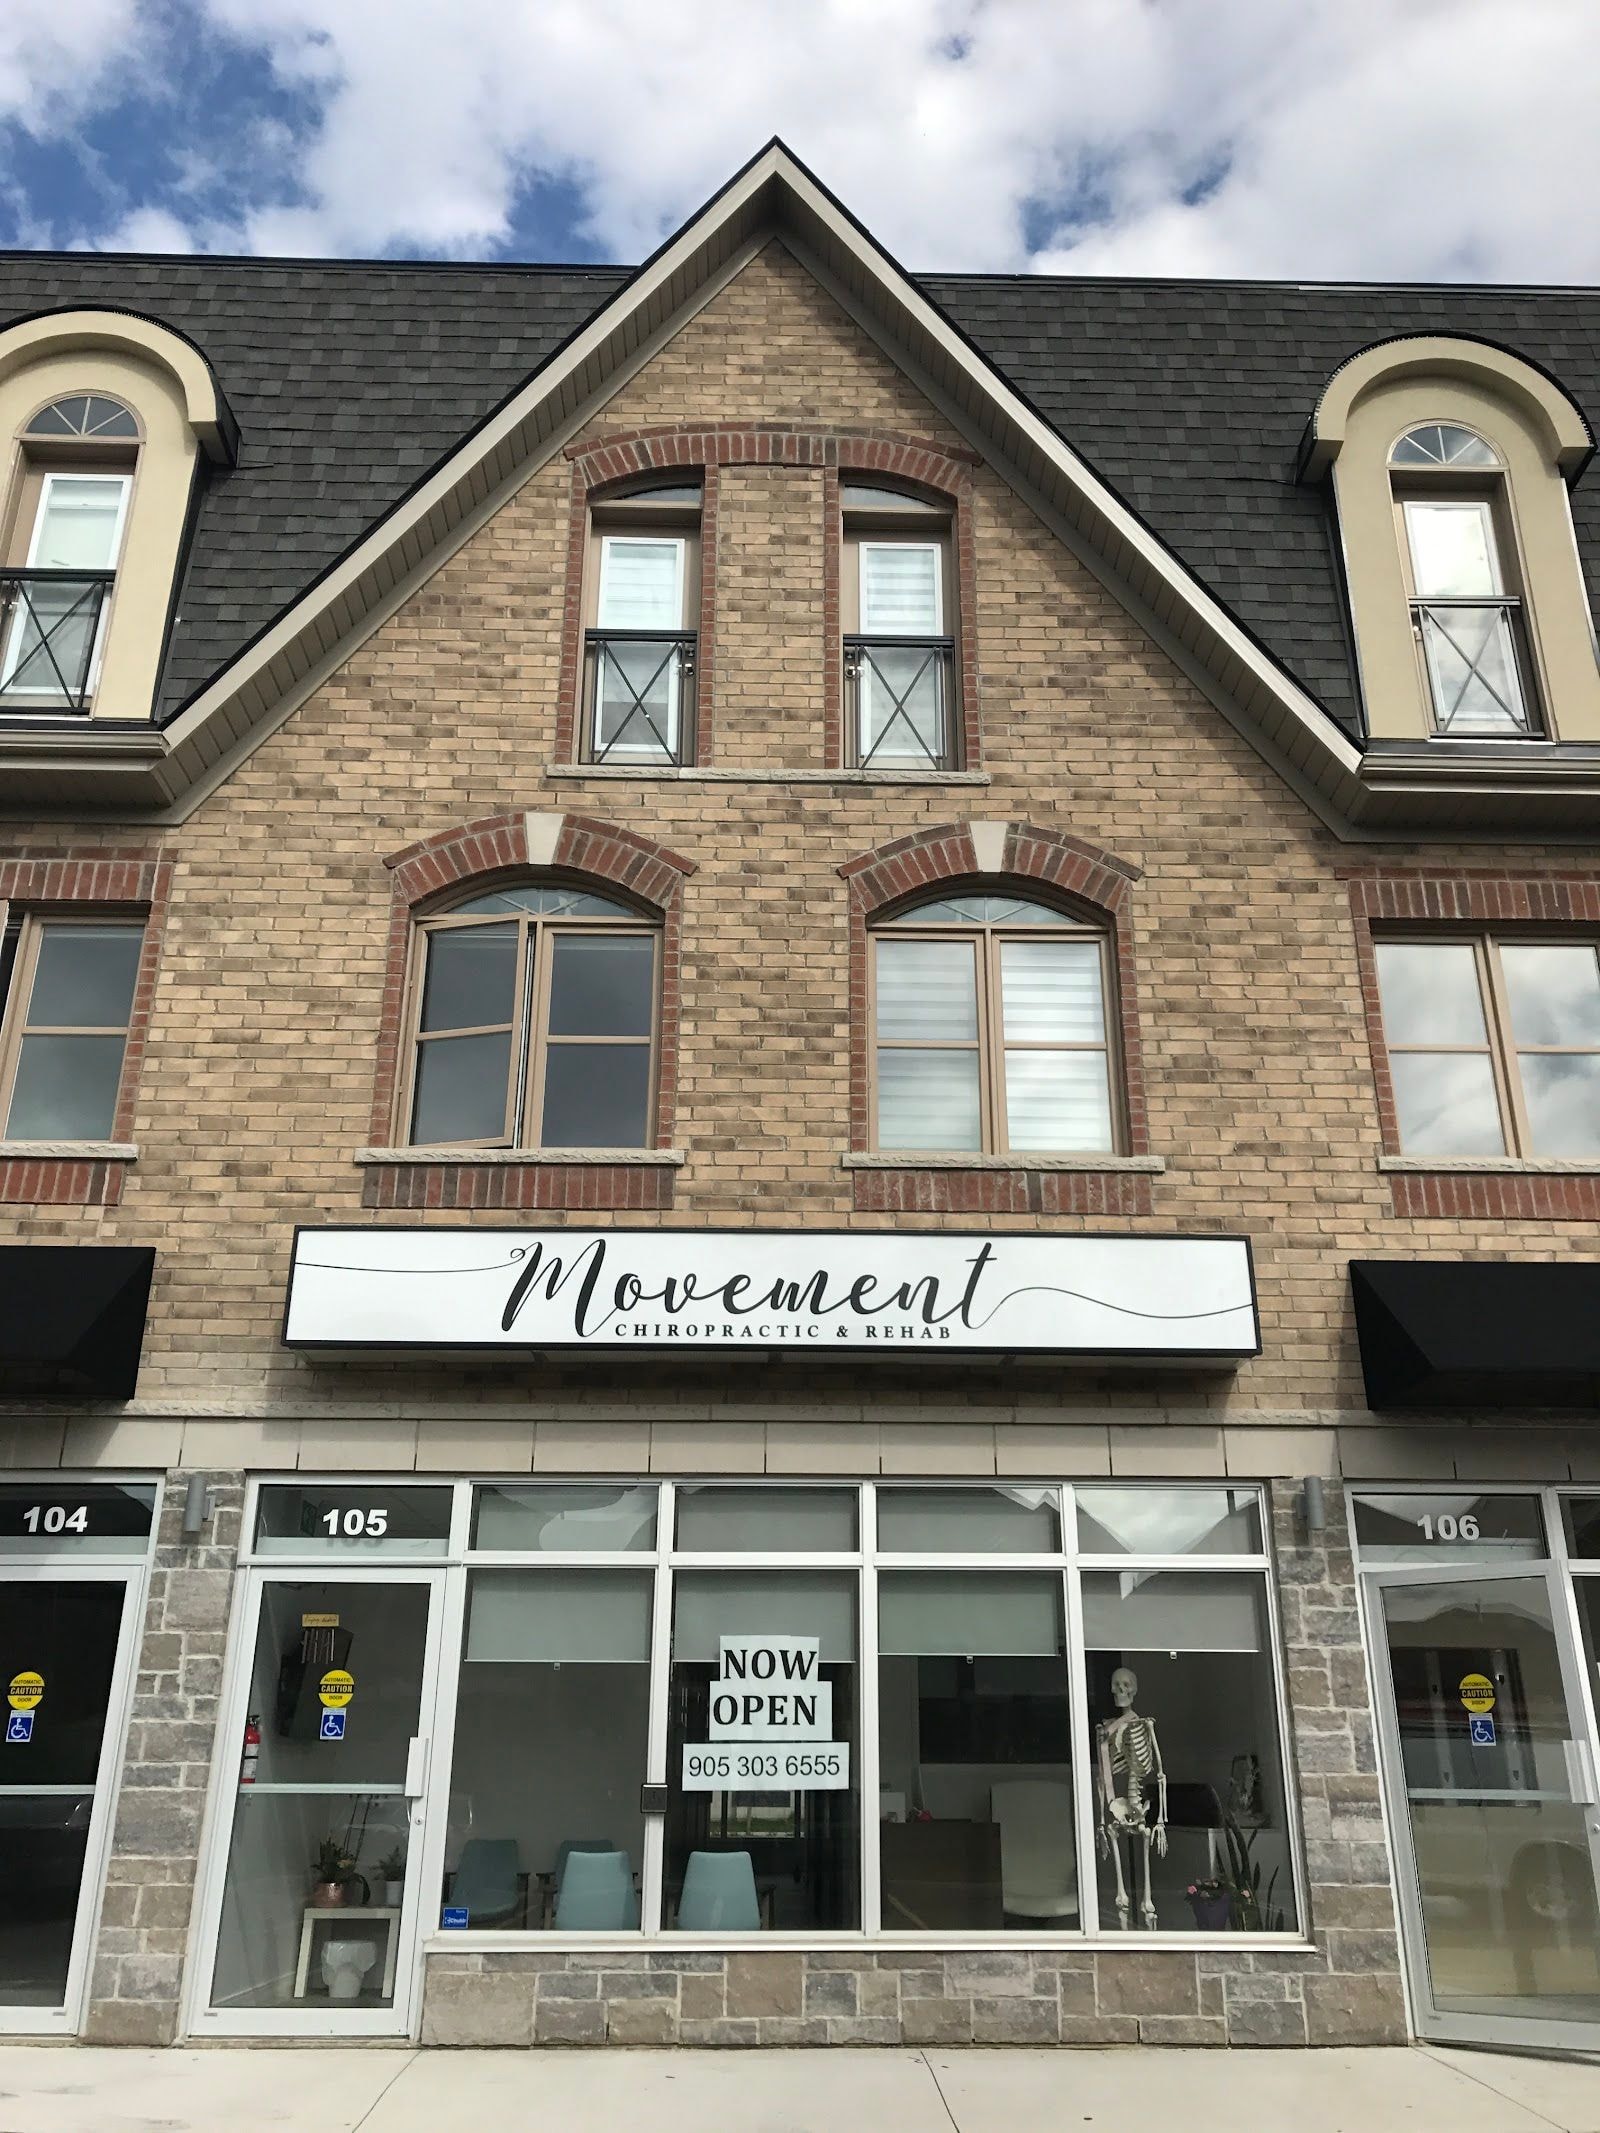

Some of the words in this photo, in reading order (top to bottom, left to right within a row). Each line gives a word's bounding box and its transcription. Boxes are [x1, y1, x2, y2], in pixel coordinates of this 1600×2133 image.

[500, 1238, 998, 1338] Movement
[615, 1323, 819, 1338] CHIROPRACTIC
[836, 1324, 849, 1338] &
[865, 1325, 951, 1339] REHAB
[23, 1506, 88, 1533] 104
[322, 1508, 388, 1537] 105
[1416, 1514, 1480, 1541] 106
[723, 1649, 818, 1680] NOW
[10, 1686, 43, 1695] CAUTION
[321, 1684, 353, 1693] CAUTION
[1461, 1689, 1494, 1698] CAUTION
[713, 1695, 818, 1726] OPEN
[689, 1756, 730, 1777] 905
[737, 1756, 778, 1777] 303
[785, 1755, 840, 1776] 6555
